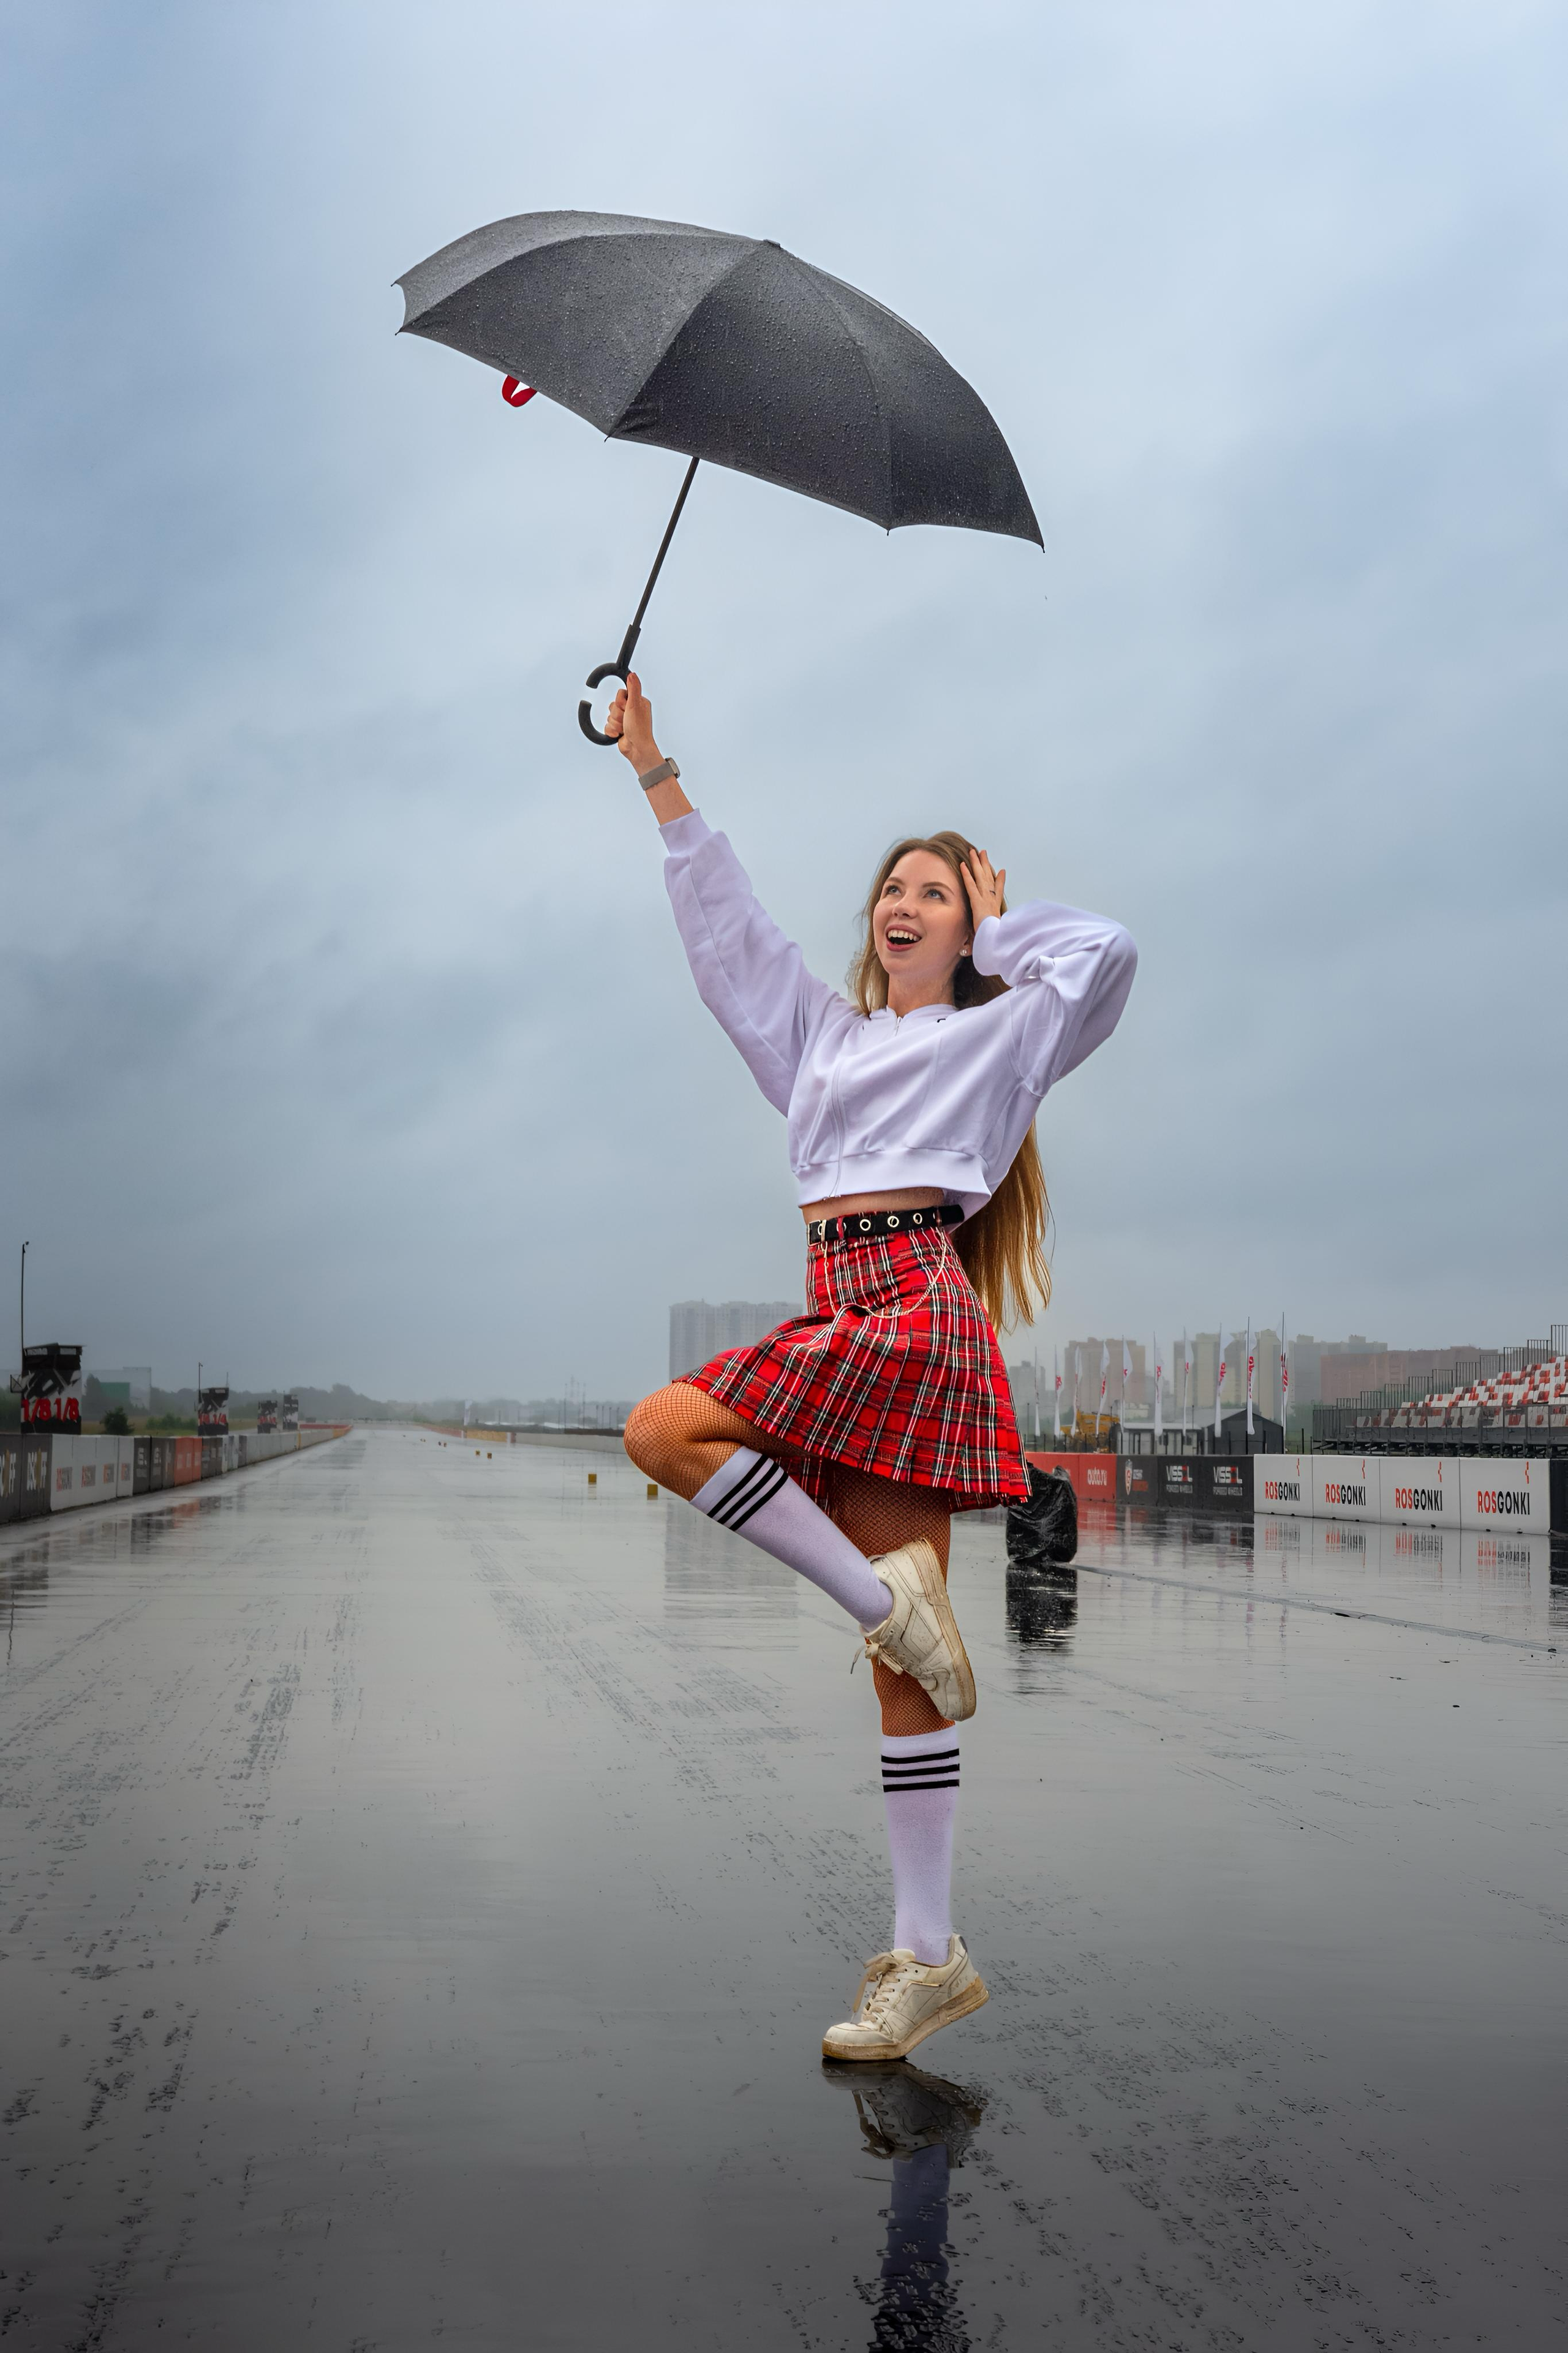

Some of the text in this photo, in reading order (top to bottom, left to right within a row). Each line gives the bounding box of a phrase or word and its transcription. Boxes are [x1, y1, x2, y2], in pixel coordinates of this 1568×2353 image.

[22, 1397, 80, 1424] 1/8 1/8
[1265, 1481, 1300, 1501] ROSGONKI
[1325, 1483, 1366, 1506] ROSGONKI
[1395, 1488, 1442, 1511] ROSGONKI
[1477, 1490, 1530, 1515] ROSGONKI
